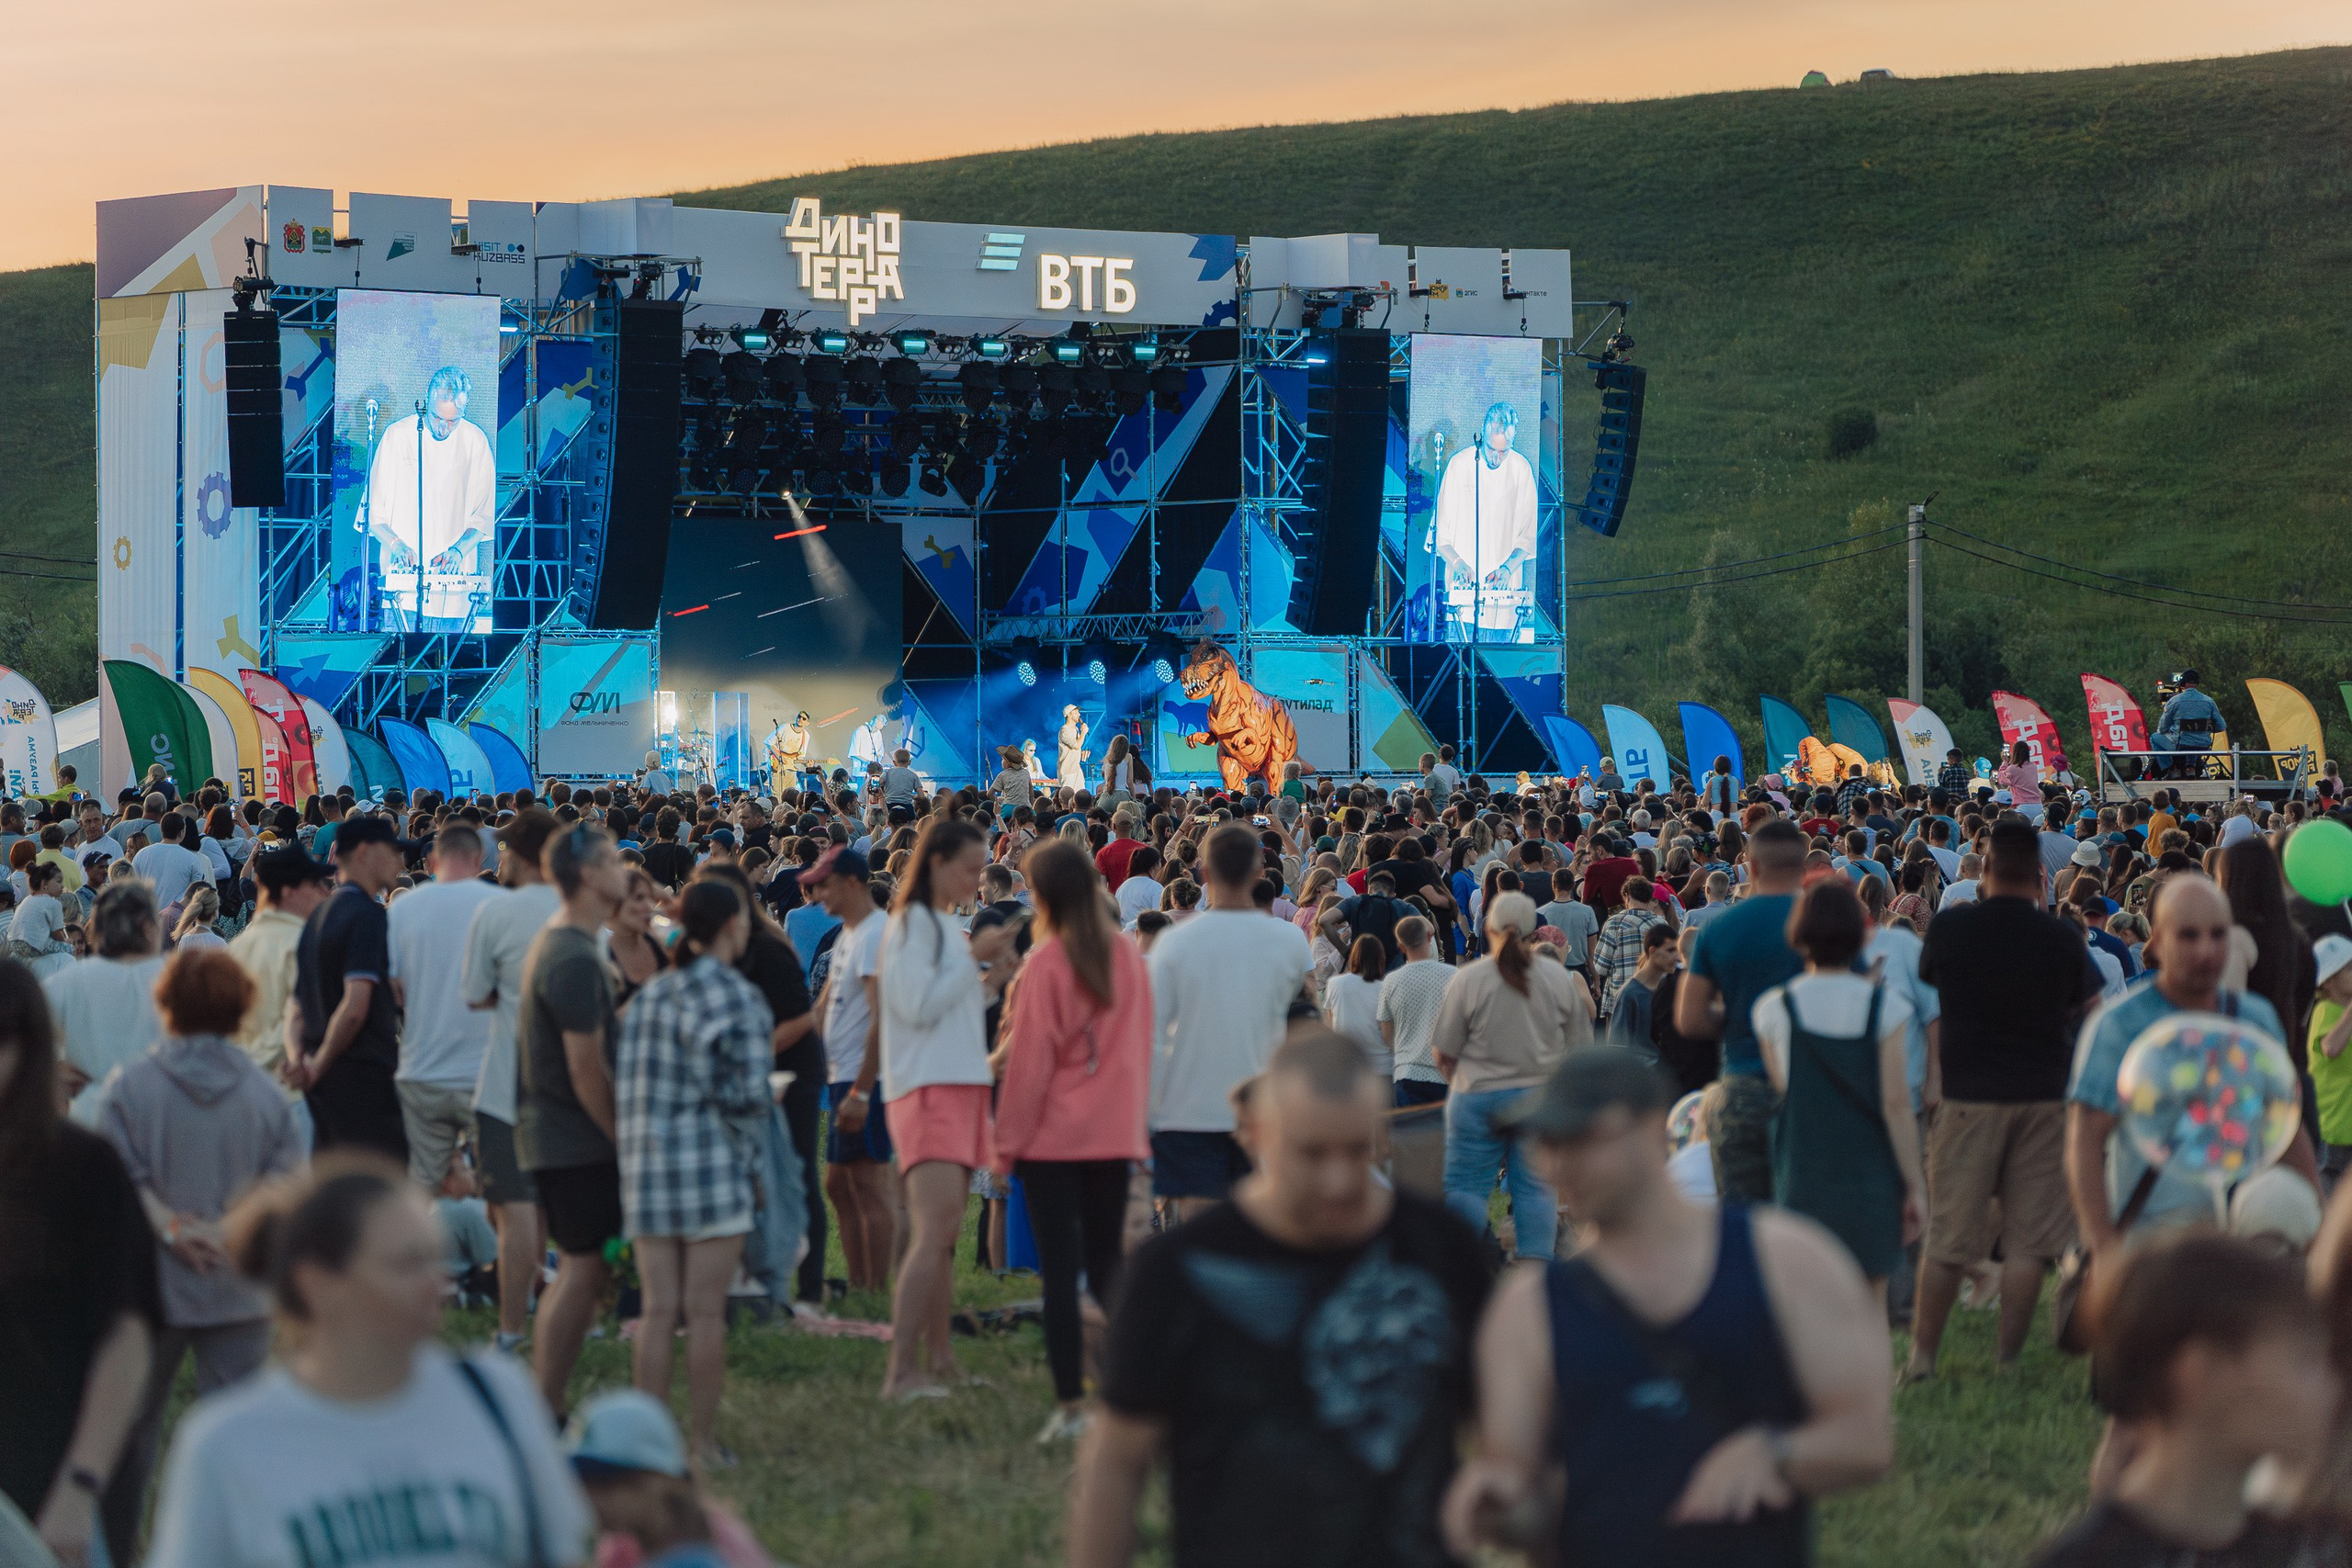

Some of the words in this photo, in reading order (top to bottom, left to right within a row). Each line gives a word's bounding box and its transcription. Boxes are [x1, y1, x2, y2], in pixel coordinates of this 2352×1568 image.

[473, 252, 526, 265] KUZBASS
[783, 197, 900, 272] ДИНО
[1038, 254, 1137, 313] ВТБ
